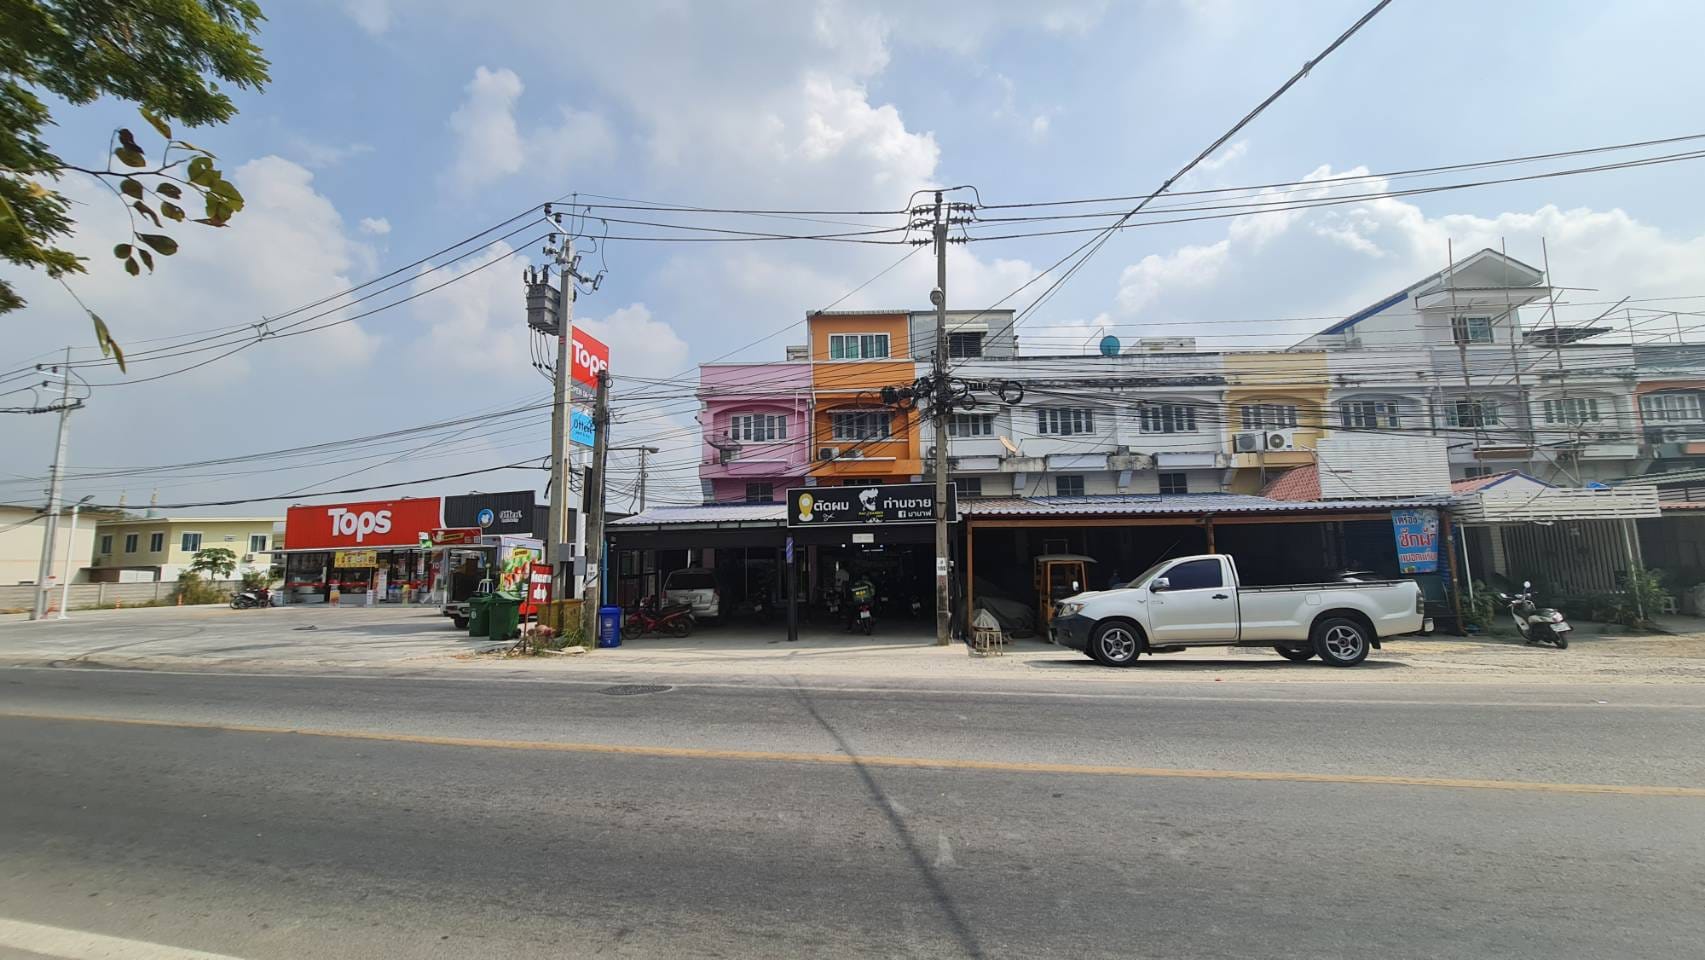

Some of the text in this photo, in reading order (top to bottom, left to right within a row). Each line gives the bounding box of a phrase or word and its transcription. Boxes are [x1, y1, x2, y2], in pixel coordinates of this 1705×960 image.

[572, 339, 608, 376] Tops
[813, 499, 850, 512] ตัดผม
[883, 498, 932, 510] ท่านชาย
[327, 508, 392, 542] Tops
